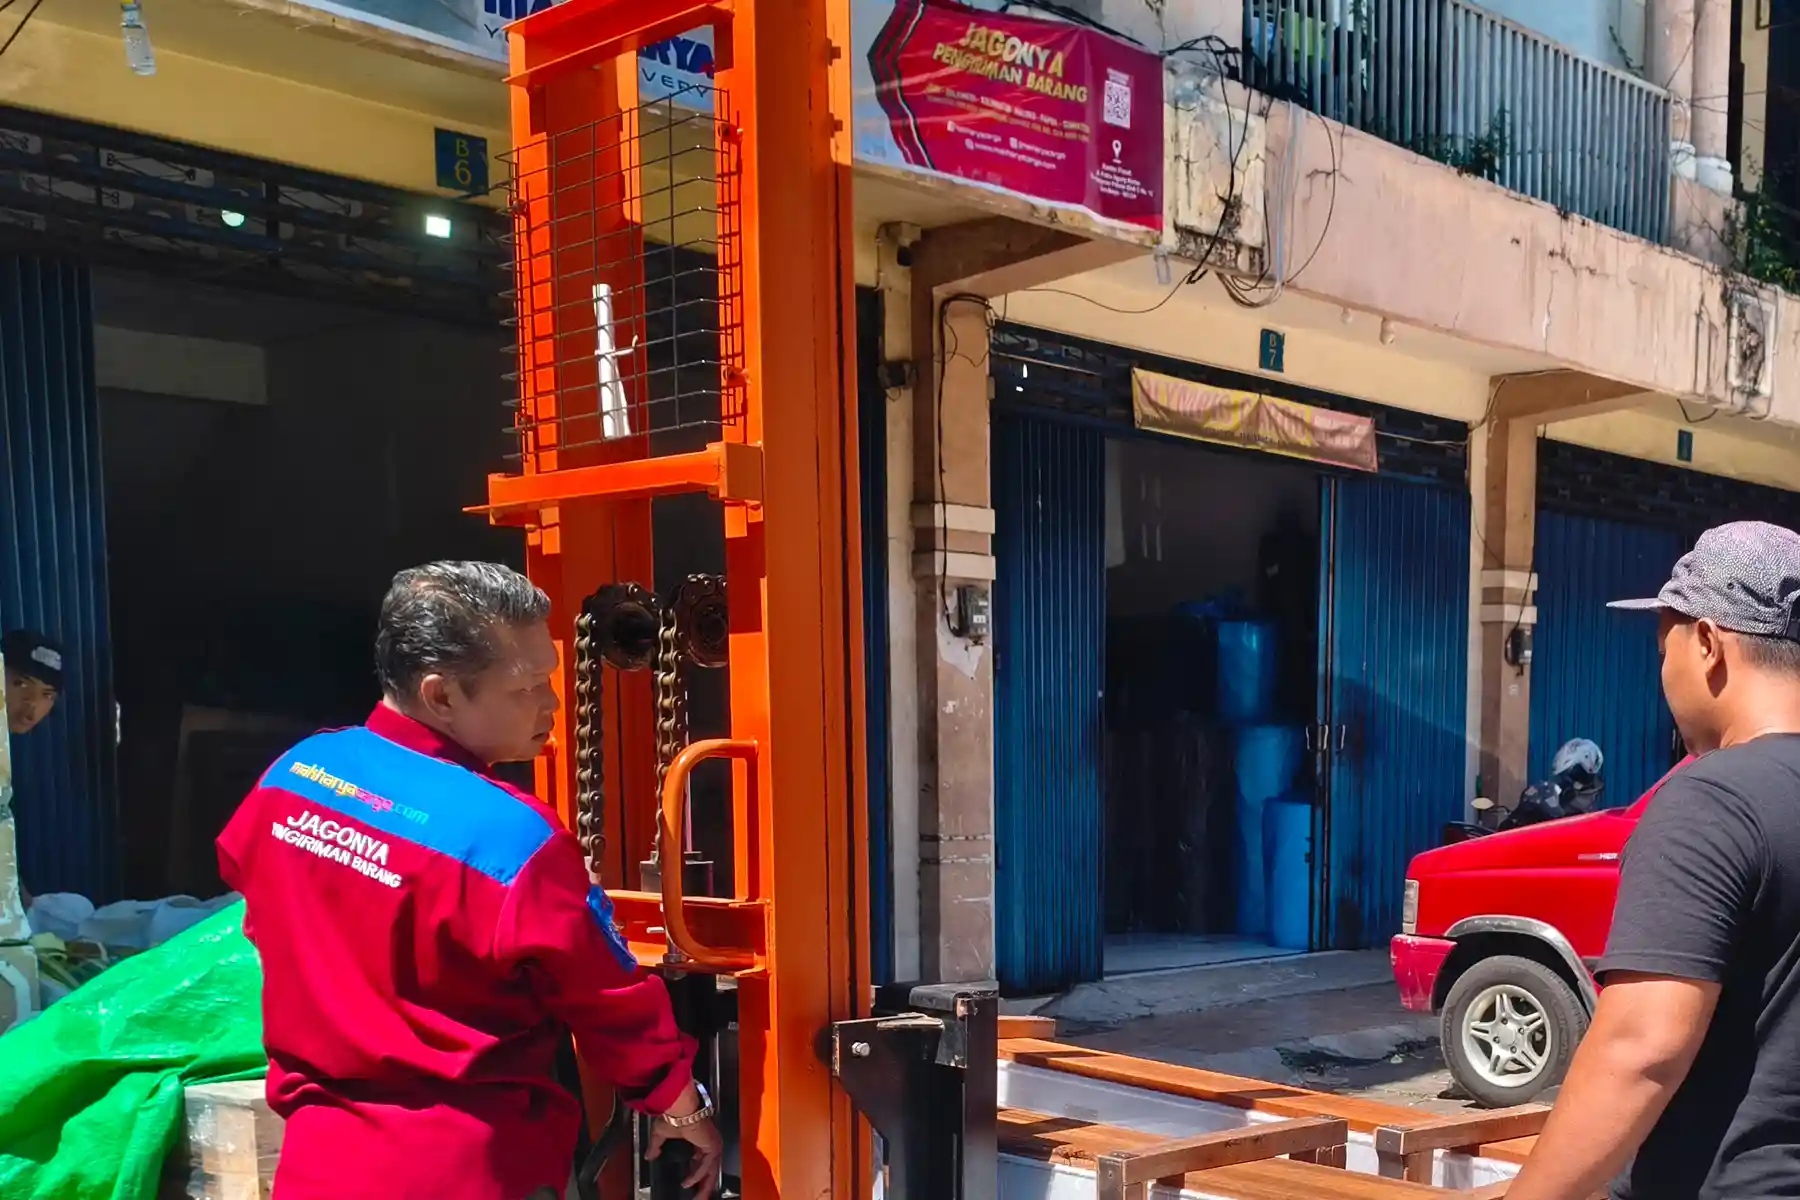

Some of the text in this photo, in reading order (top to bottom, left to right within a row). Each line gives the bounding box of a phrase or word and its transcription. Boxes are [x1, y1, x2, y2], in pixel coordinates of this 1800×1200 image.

[958, 22, 1064, 78] JAGONYA
[1026, 72, 1088, 103] BARANG
[455, 138, 470, 157] B
[454, 160, 472, 186] 6
[286, 810, 390, 866] JAGONYA
[351, 855, 403, 889] BARANG
